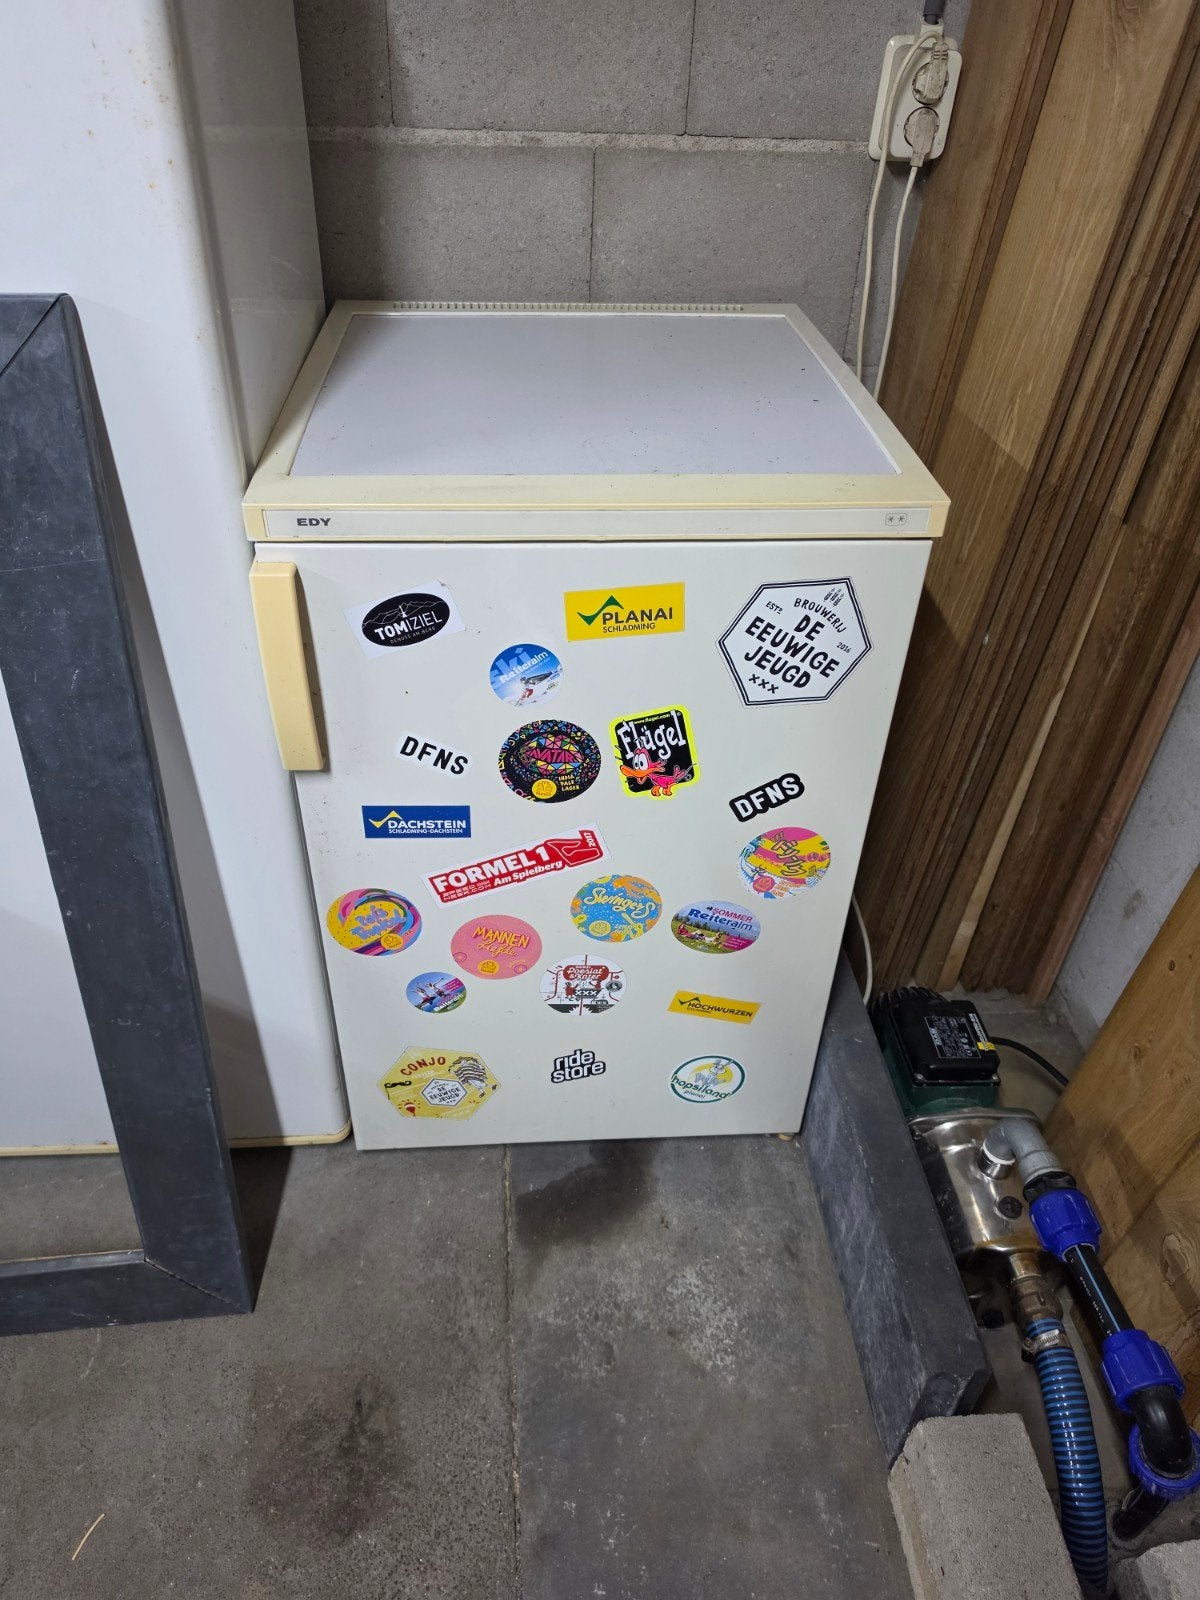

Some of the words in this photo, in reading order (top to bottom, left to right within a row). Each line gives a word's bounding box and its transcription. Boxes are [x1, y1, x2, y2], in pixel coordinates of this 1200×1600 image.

[296, 517, 331, 527] EDY
[374, 611, 443, 640] TOMIZIEL
[602, 607, 673, 625] PLANAI
[793, 598, 847, 633] BROUWERIJ
[603, 622, 656, 633] SCHLADMING
[793, 614, 825, 641] DE
[744, 615, 840, 678] EEUWIGE
[499, 651, 549, 684] Reiteralm
[743, 646, 811, 688] JEUGD
[617, 710, 686, 760] Flügel
[400, 736, 469, 775] DFNS
[734, 777, 800, 818] DFNS
[388, 820, 467, 829] DACHSTEIN
[584, 832, 596, 847] 2017
[433, 853, 536, 893] FORMEL
[536, 846, 550, 862] 1
[494, 875, 512, 886] Am
[513, 860, 563, 881] Spielberg
[687, 908, 753, 931] Reiteralm
[712, 907, 753, 922] SOMMER
[471, 926, 530, 949] MANNEN
[688, 1001, 753, 1017] HOCHWURZEN
[400, 1056, 446, 1076] CONJO
[555, 1049, 594, 1070] ride
[552, 1062, 605, 1082] store
